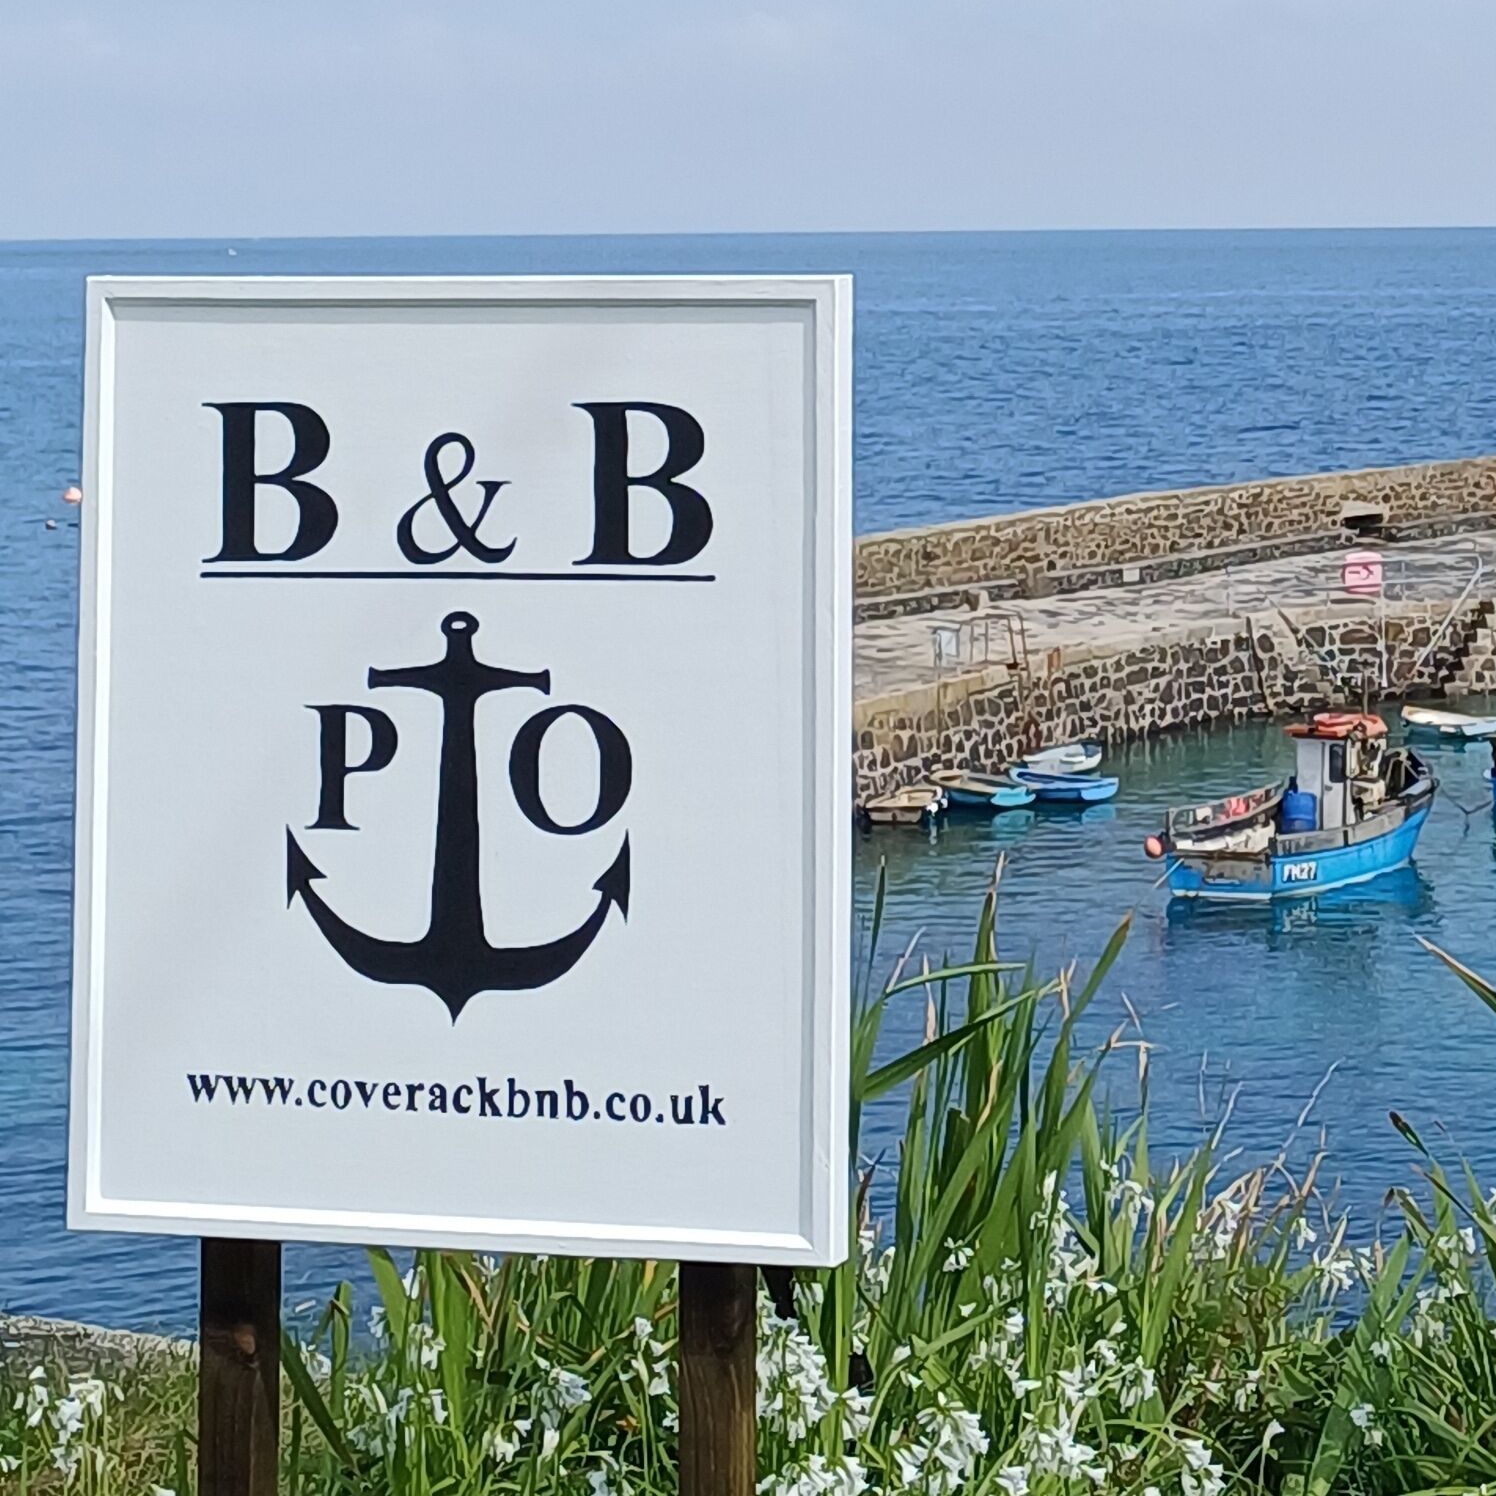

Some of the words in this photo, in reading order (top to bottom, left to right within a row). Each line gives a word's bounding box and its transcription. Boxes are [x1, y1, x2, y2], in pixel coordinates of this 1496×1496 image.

[202, 401, 339, 564] B
[396, 432, 518, 565] &
[571, 401, 714, 566] B
[304, 704, 399, 831] P
[508, 703, 633, 836] O
[186, 1073, 727, 1127] www.coverackbnb.co.uk
